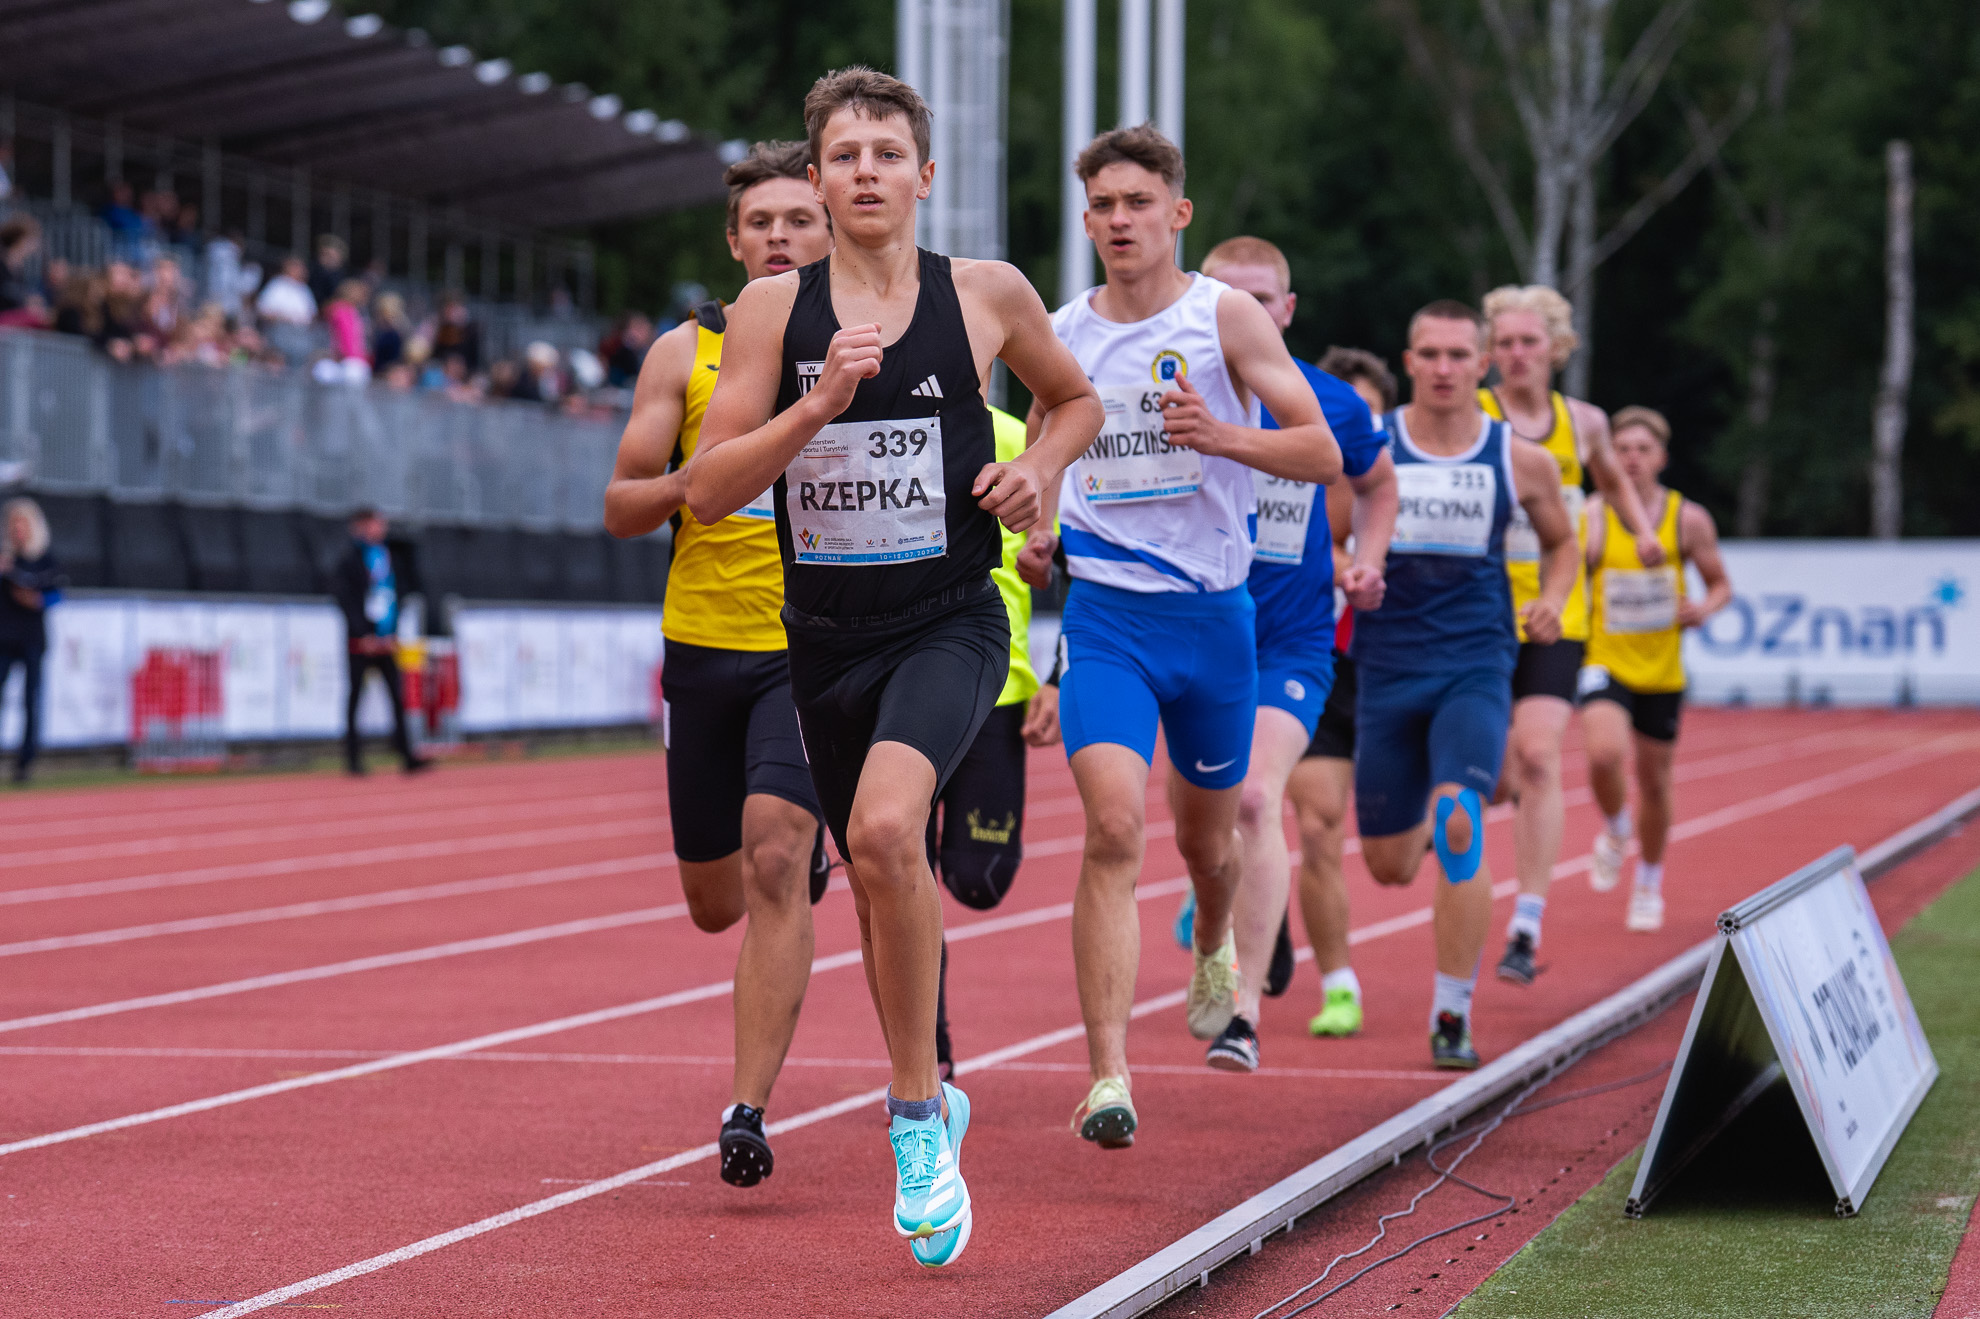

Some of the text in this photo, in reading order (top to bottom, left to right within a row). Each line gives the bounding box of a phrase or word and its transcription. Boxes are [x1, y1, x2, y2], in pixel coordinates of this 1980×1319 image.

[806, 365, 816, 373] W
[868, 428, 928, 458] 339
[1082, 425, 1195, 460] WIDZIŃS
[799, 477, 930, 511] RZEPKA
[1399, 496, 1485, 518] PECYNA
[1257, 497, 1306, 524] WSKI
